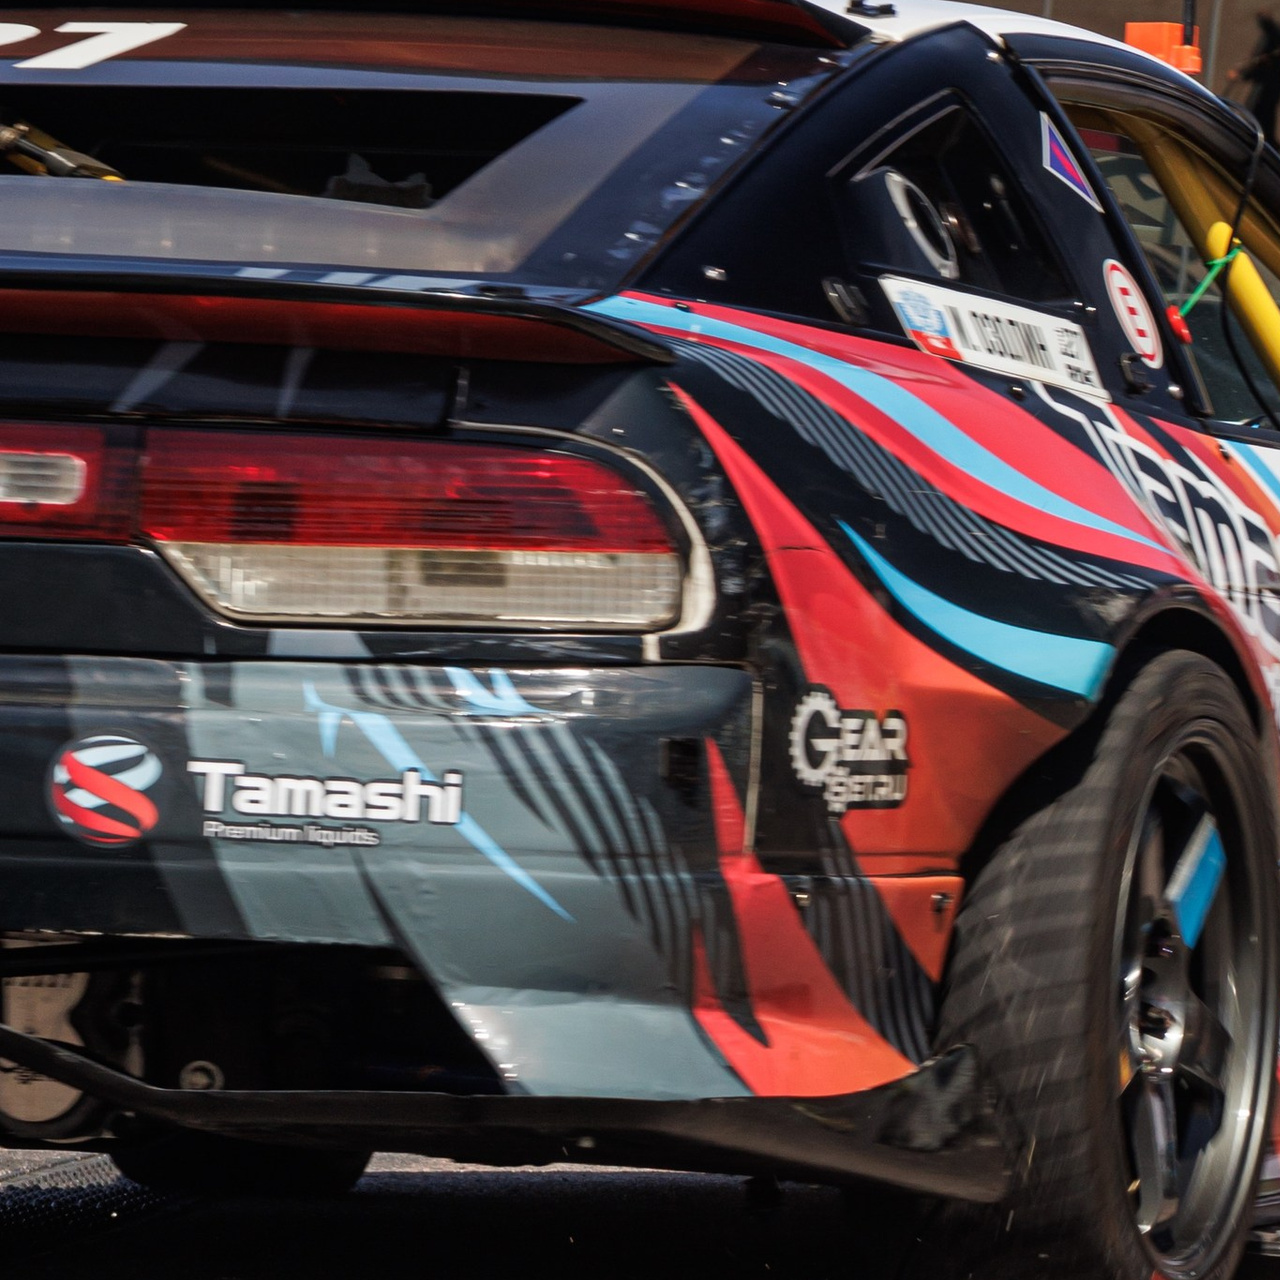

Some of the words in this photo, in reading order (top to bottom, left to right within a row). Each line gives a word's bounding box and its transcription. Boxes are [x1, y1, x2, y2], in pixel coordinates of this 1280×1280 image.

[186, 760, 462, 824] Tamashi
[202, 819, 303, 841] Premium
[305, 825, 380, 847] liquids
